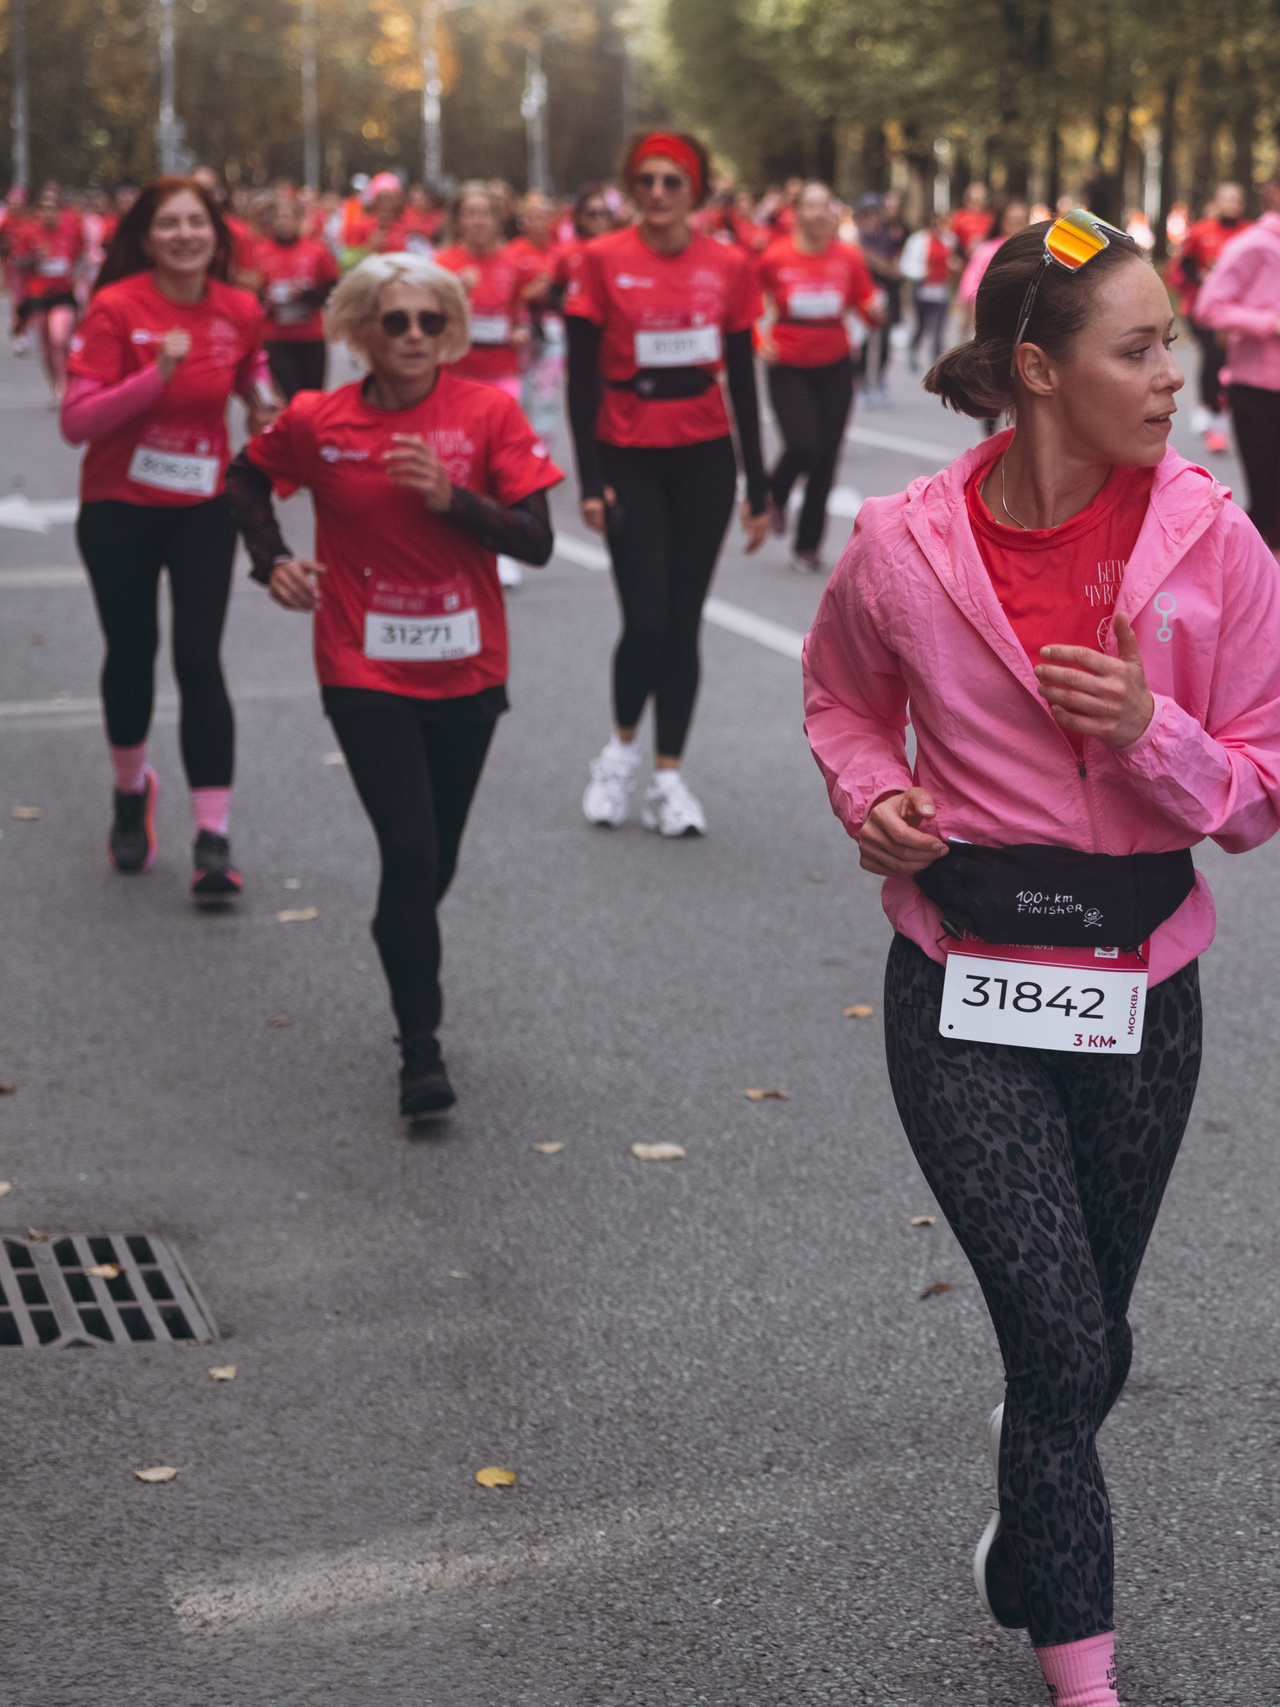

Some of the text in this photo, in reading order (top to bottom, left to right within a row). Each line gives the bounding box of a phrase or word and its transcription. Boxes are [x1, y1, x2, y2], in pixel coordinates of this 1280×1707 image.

[380, 622, 451, 645] 31271
[1016, 891, 1050, 904] 100+
[961, 974, 1106, 1020] 31842
[1127, 985, 1139, 1035] МОСКВА
[1073, 1033, 1082, 1047] 3
